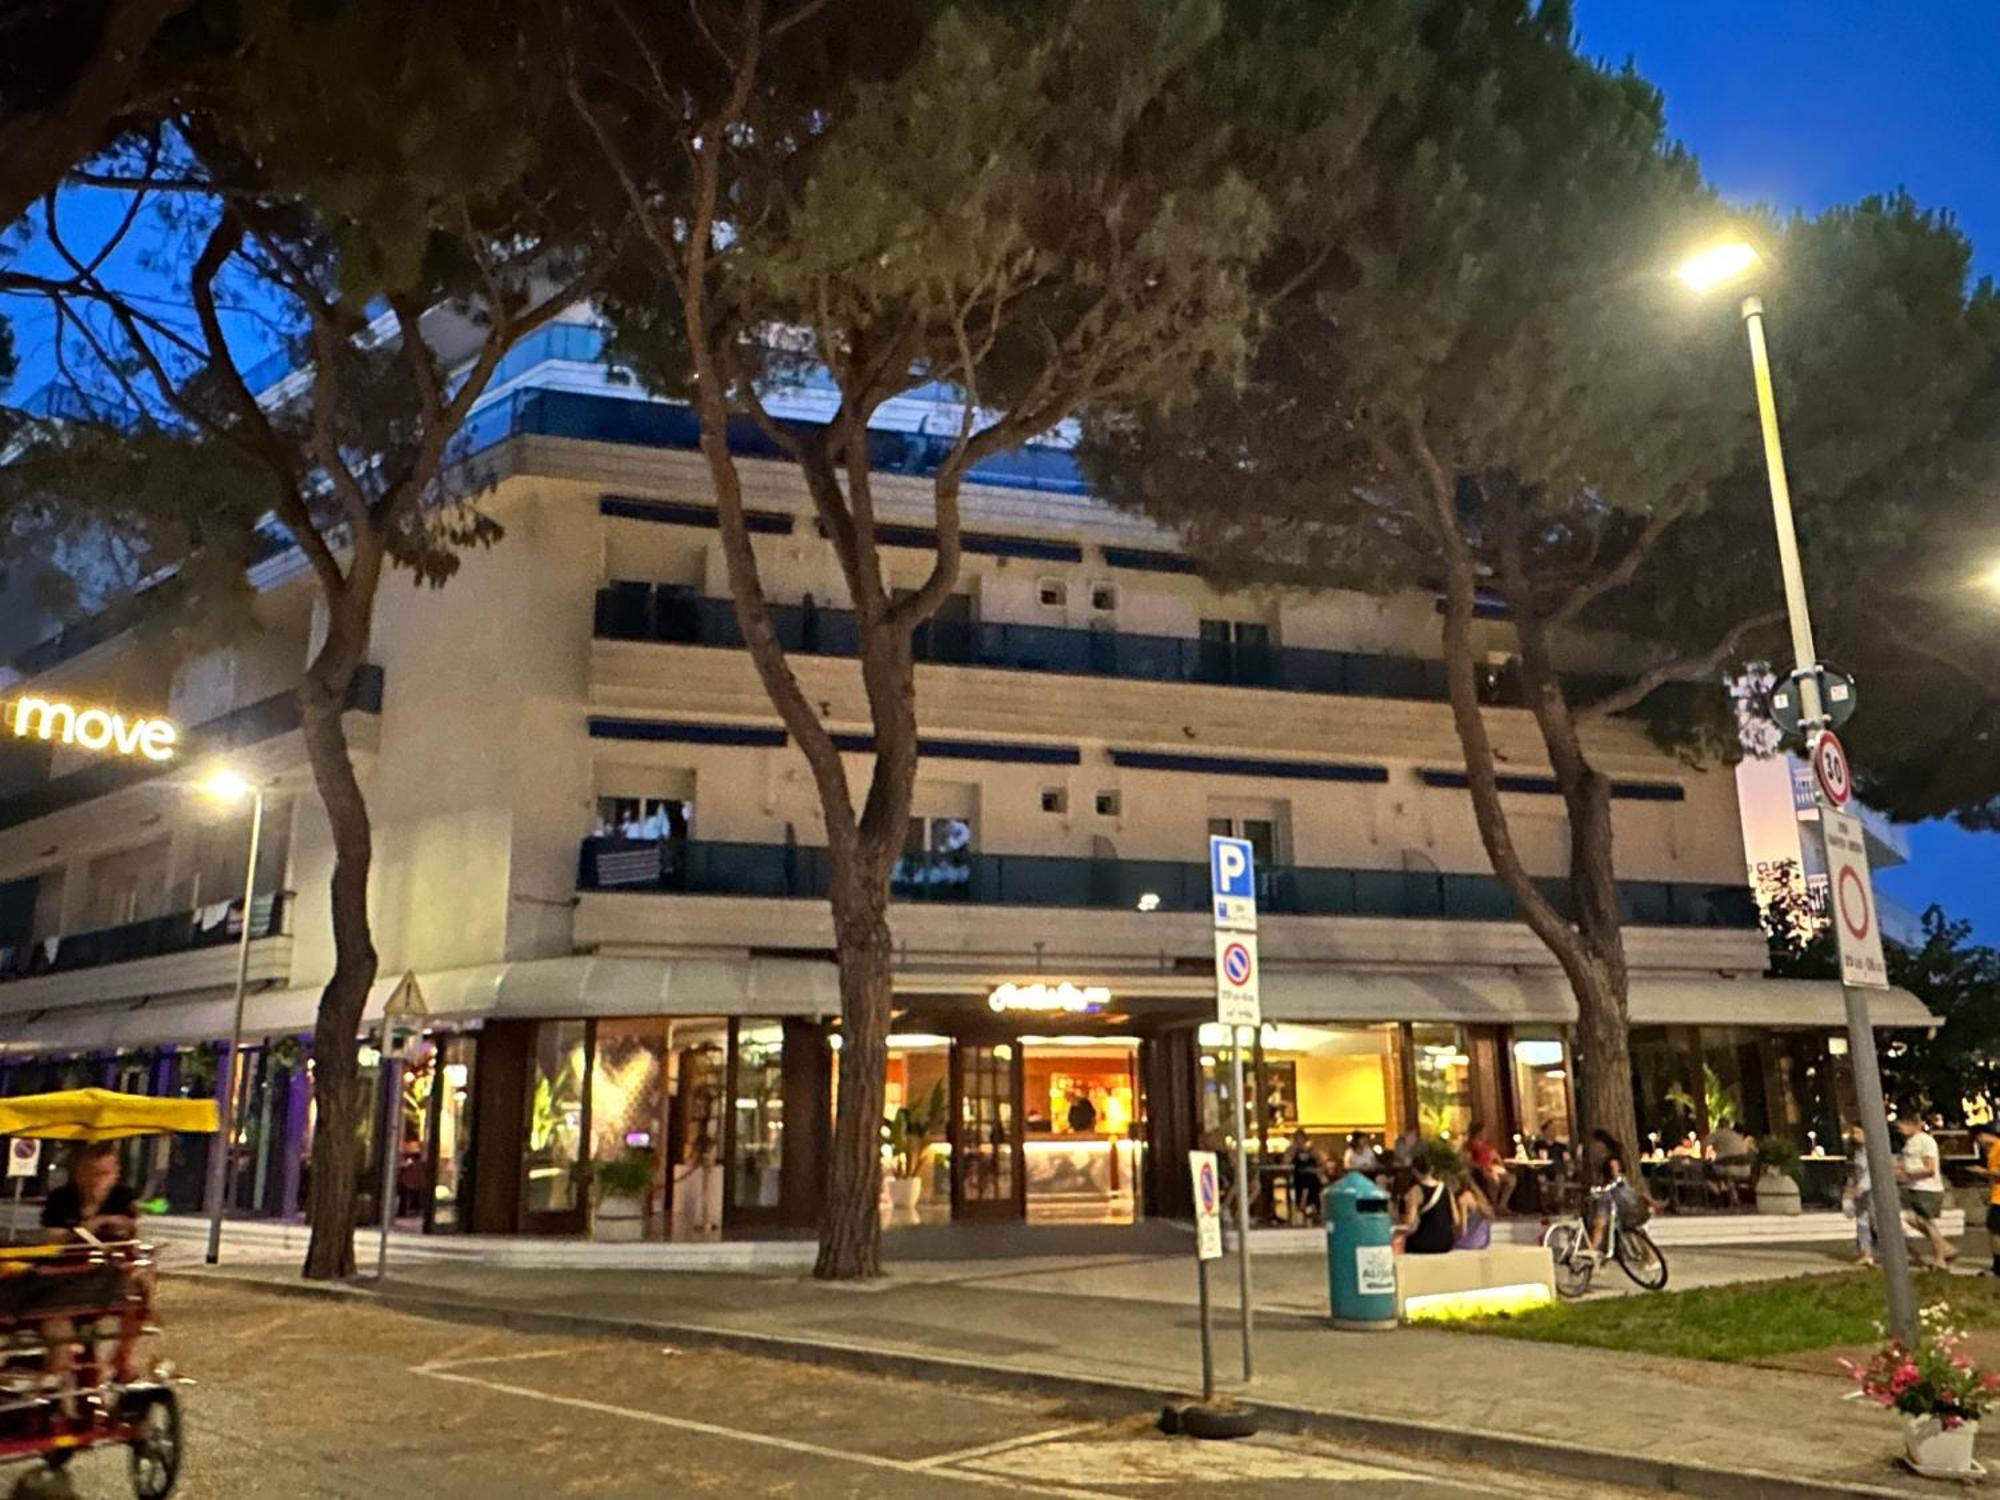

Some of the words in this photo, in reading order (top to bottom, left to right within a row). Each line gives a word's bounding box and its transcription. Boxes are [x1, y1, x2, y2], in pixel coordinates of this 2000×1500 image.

[14, 697, 177, 761] move
[1825, 752, 1842, 784] 30
[1219, 844, 1245, 892] P
